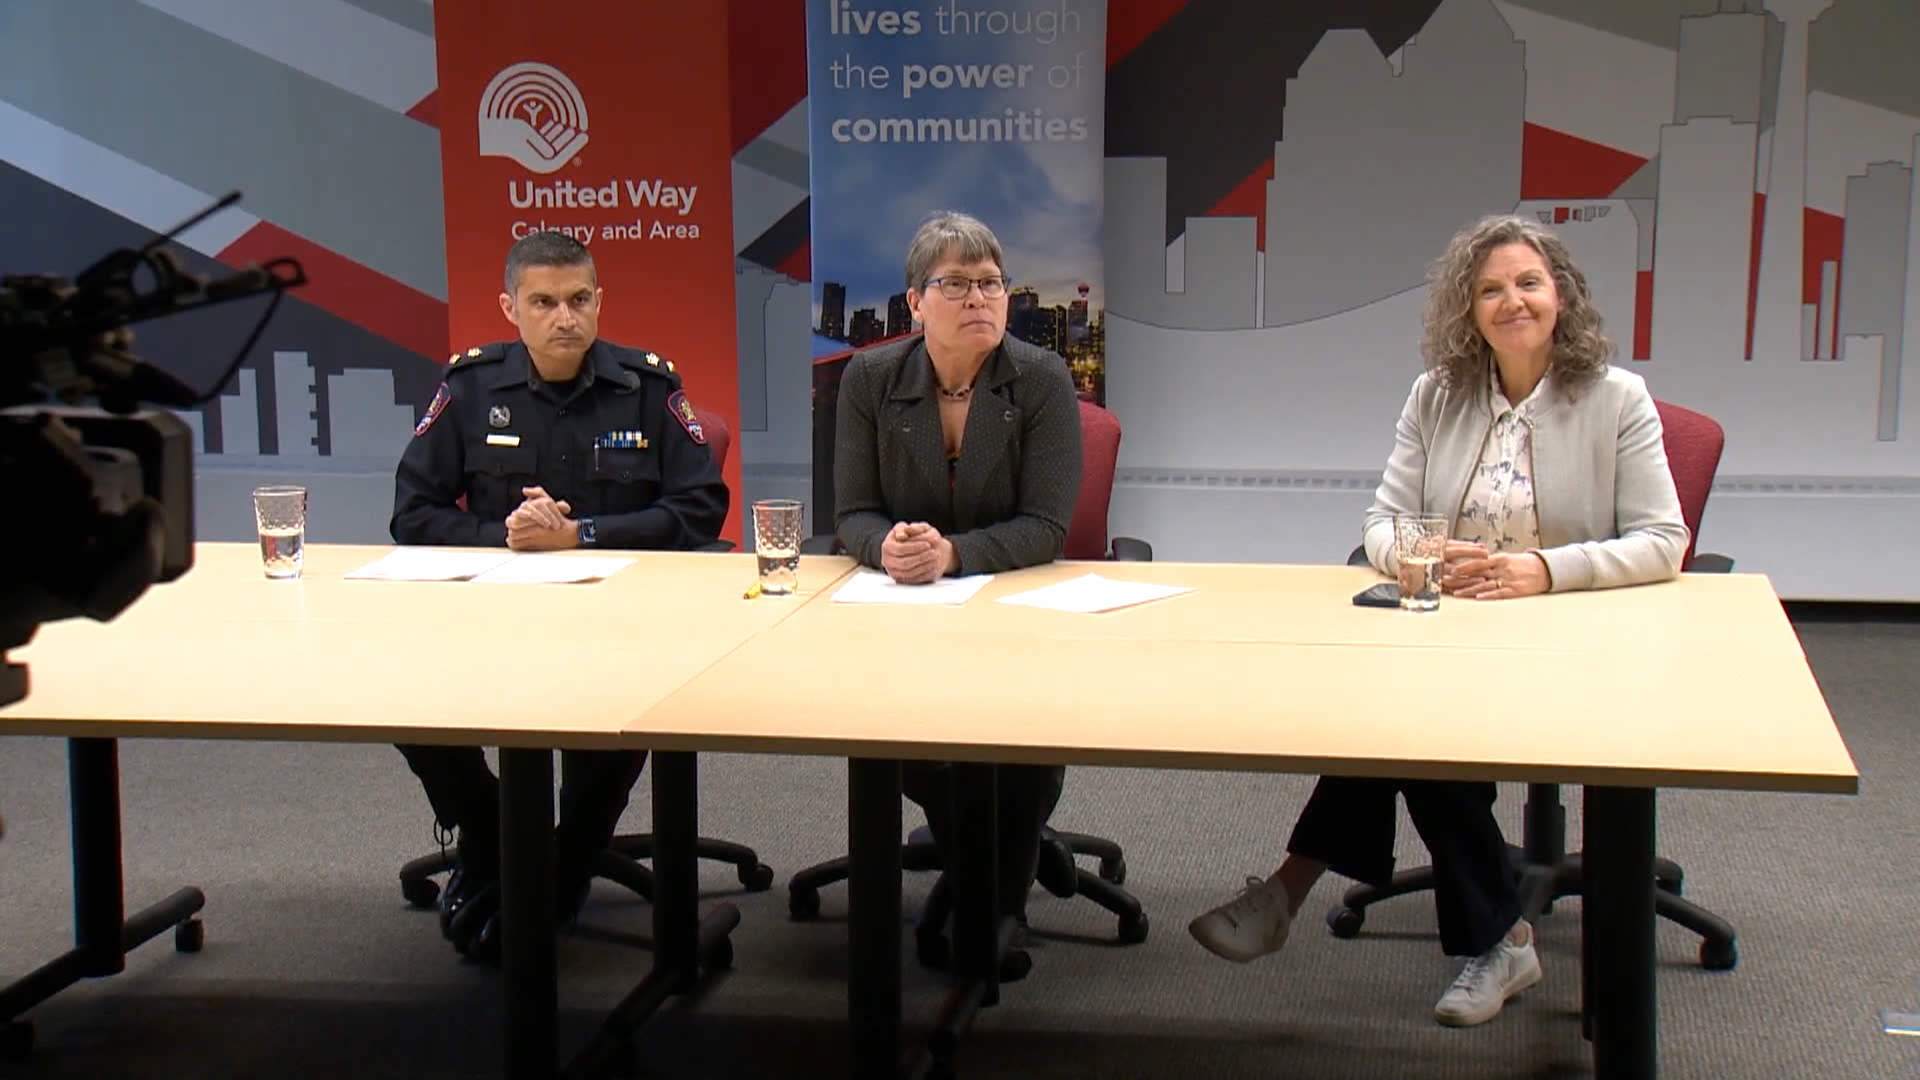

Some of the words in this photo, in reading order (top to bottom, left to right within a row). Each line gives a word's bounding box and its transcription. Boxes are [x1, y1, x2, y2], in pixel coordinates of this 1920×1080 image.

[829, 0, 922, 35] lives
[935, 0, 1081, 44] through
[830, 53, 889, 89] the
[903, 63, 1034, 98] power
[1048, 52, 1085, 88] of
[831, 107, 1089, 143] communities
[509, 180, 619, 208] United
[626, 179, 698, 215] Way
[602, 219, 642, 240] and
[650, 221, 700, 240] Area
